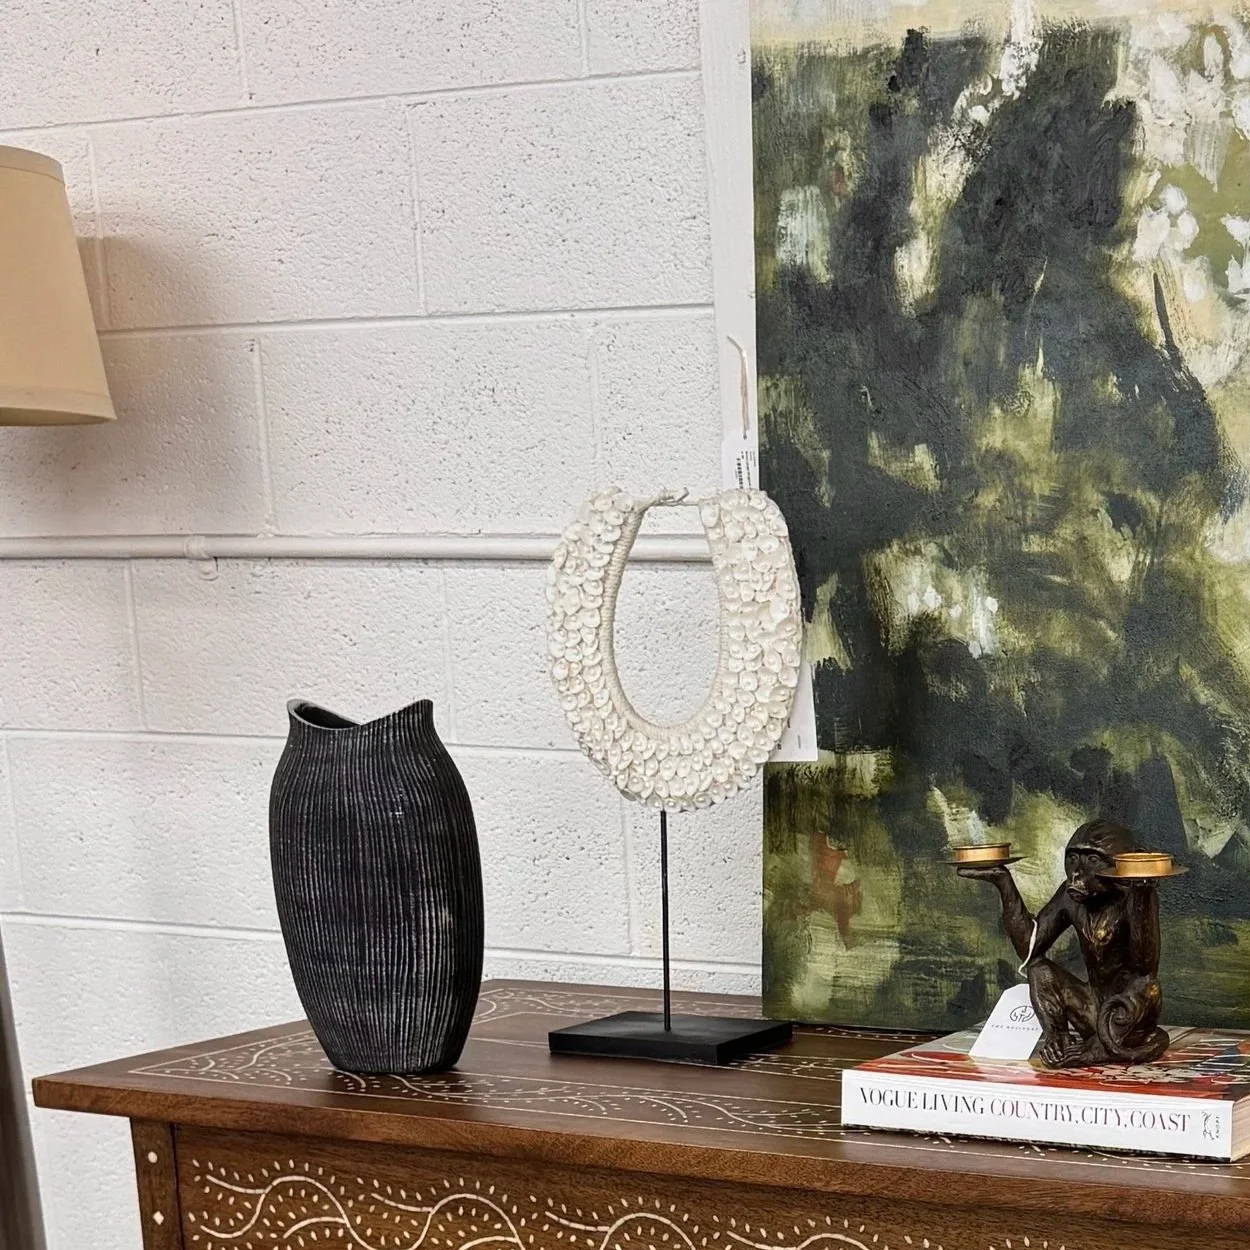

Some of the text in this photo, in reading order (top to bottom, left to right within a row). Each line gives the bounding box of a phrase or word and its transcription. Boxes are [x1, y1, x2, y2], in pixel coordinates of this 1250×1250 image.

[859, 1087, 918, 1110] VOGUE
[922, 1092, 984, 1115] LIVING
[1130, 1109, 1191, 1132] COAST
